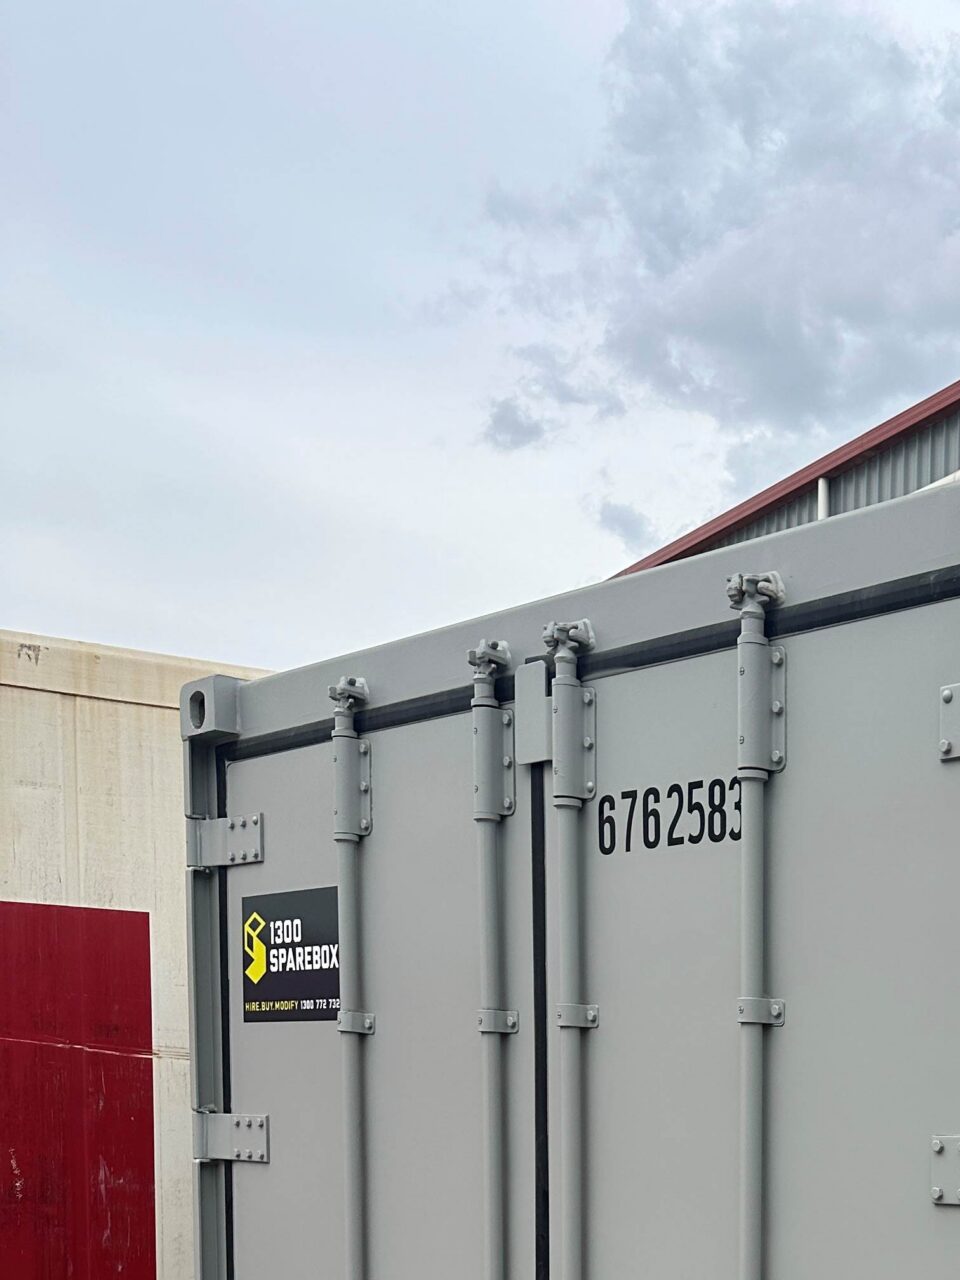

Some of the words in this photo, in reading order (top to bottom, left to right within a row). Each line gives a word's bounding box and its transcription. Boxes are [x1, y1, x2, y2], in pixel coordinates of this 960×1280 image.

[598, 776, 742, 855] 6762583
[269, 918, 302, 945] 1300
[269, 943, 339, 972] SPAREBOX
[245, 1001, 299, 1012] HIRE.BUY.MODIFY
[300, 999, 314, 1010] 1300
[316, 999, 327, 1010] 772
[328, 998, 340, 1009] 732
